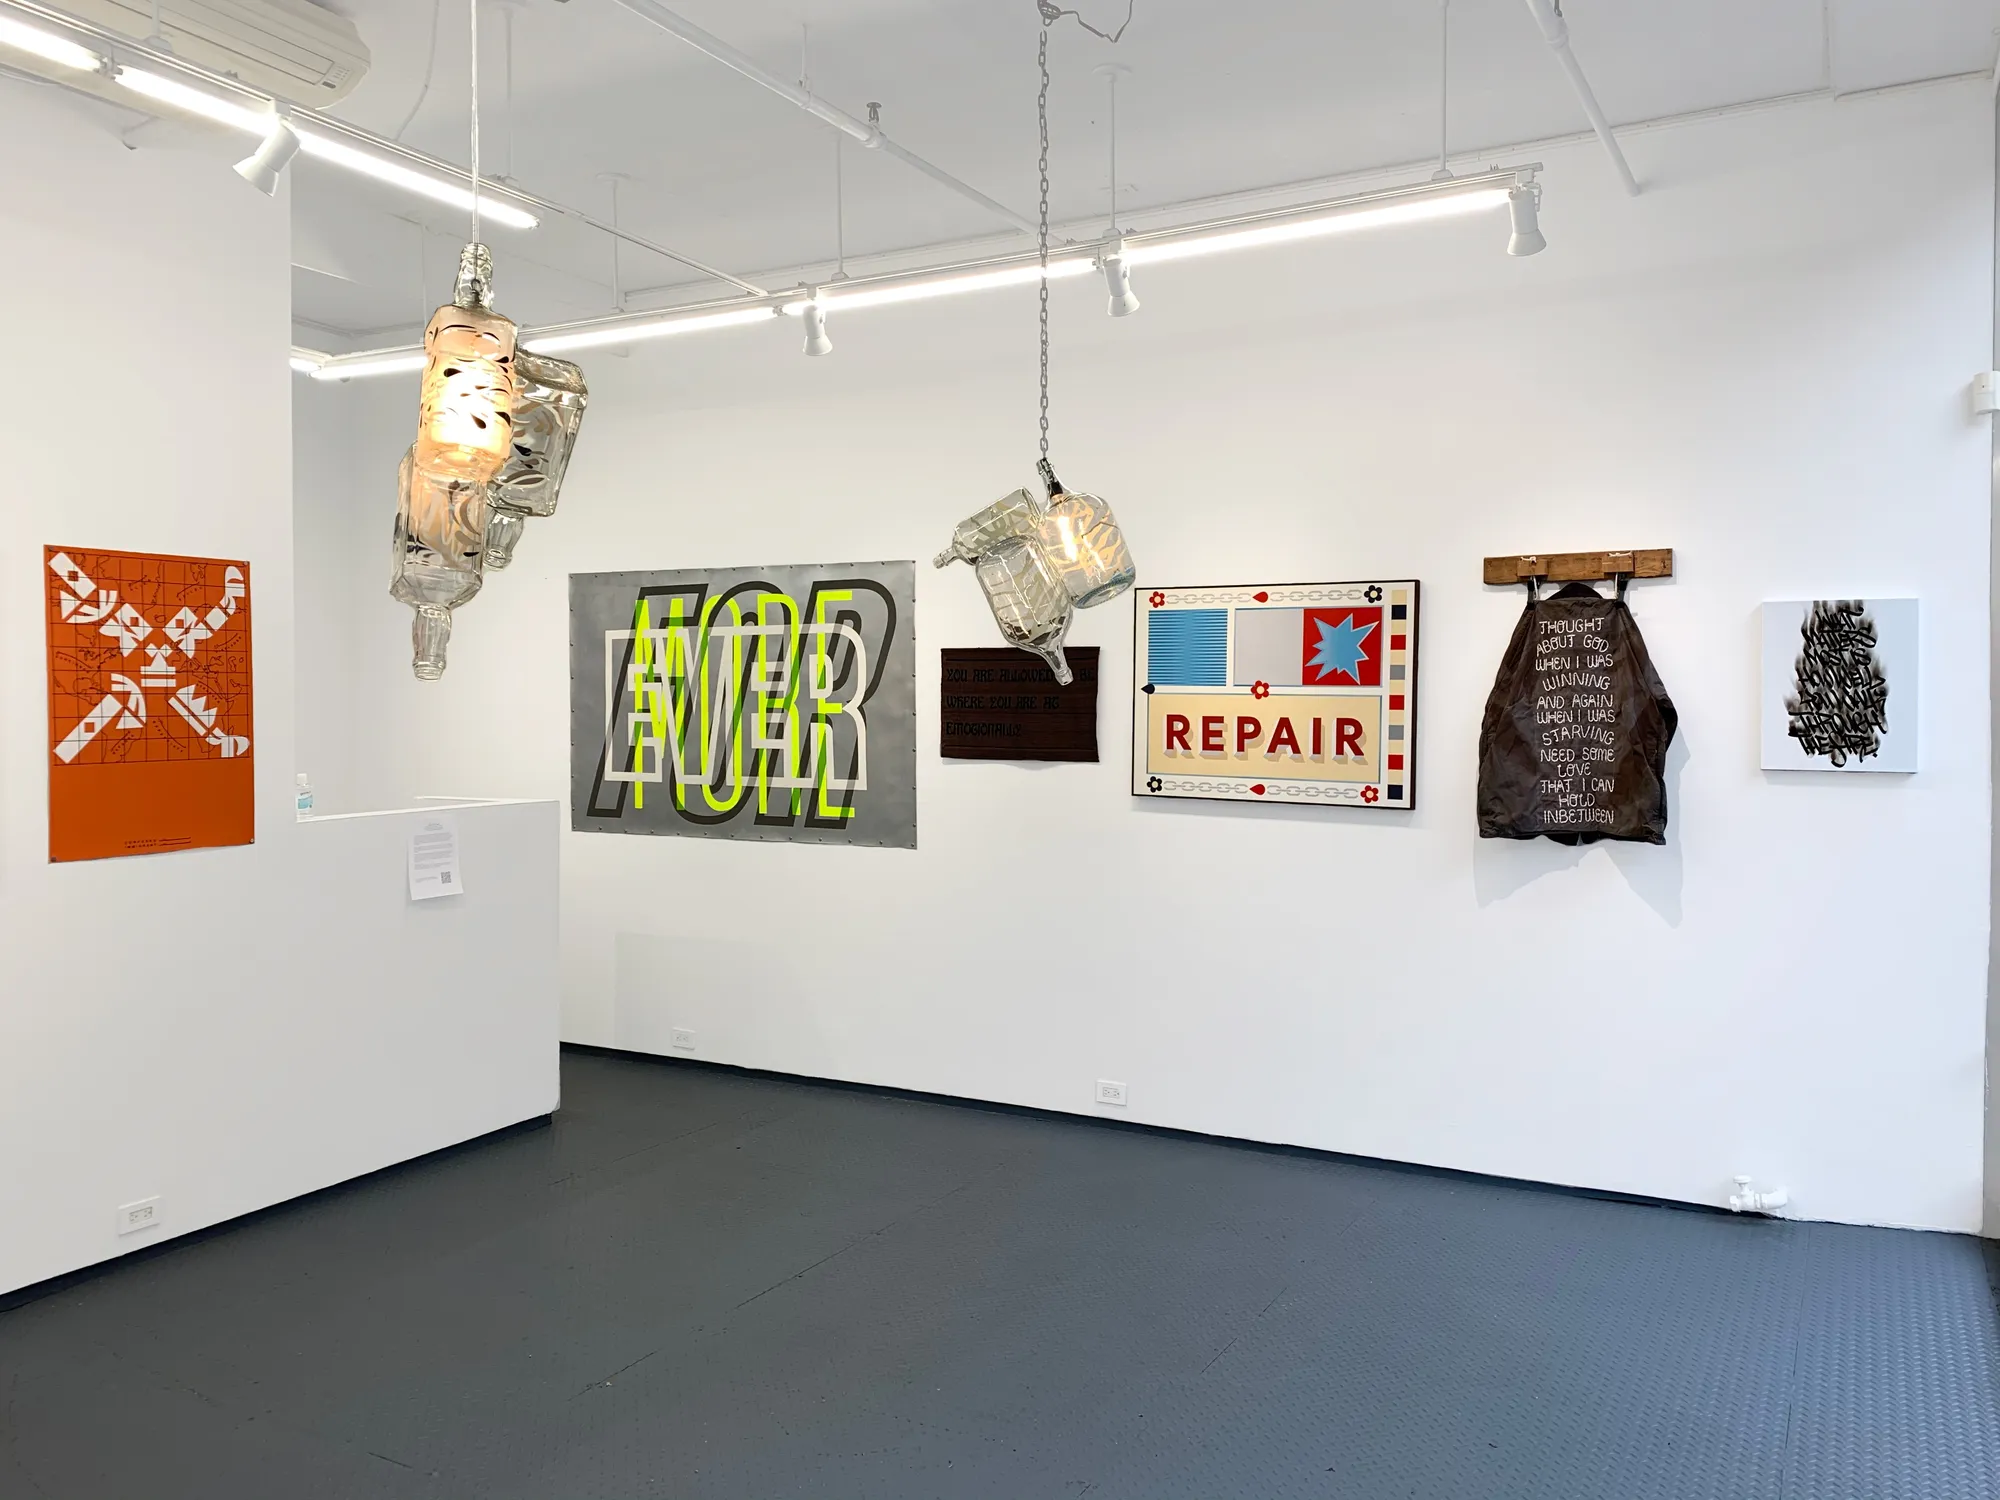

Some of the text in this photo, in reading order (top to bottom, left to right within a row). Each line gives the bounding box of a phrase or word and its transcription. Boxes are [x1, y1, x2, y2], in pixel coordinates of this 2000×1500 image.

[1539, 617, 1605, 635] THOUGHT
[1536, 634, 1609, 657] ABOUT GOD
[1535, 653, 1614, 671] WHEN I WAS
[947, 668, 968, 683] YOU
[973, 669, 994, 683] ARE
[1000, 668, 1055, 683] ALLOWED
[1542, 672, 1611, 692] WINNING
[604, 623, 867, 790] EVER
[634, 590, 855, 818] MORE
[946, 696, 1060, 710] WHERE YOU ARE AT
[1536, 694, 1613, 709] AND AGAIN
[1536, 709, 1616, 724] WHEN I WAS
[1164, 714, 1365, 758] REPAIR
[1541, 724, 1615, 746] STARVING
[1540, 747, 1615, 763] NEED SOME
[1557, 762, 1592, 778] LOVE
[1540, 778, 1615, 794] THAT I CAN
[1558, 793, 1596, 807] HOLD
[1543, 808, 1615, 824] INBETWEEN
